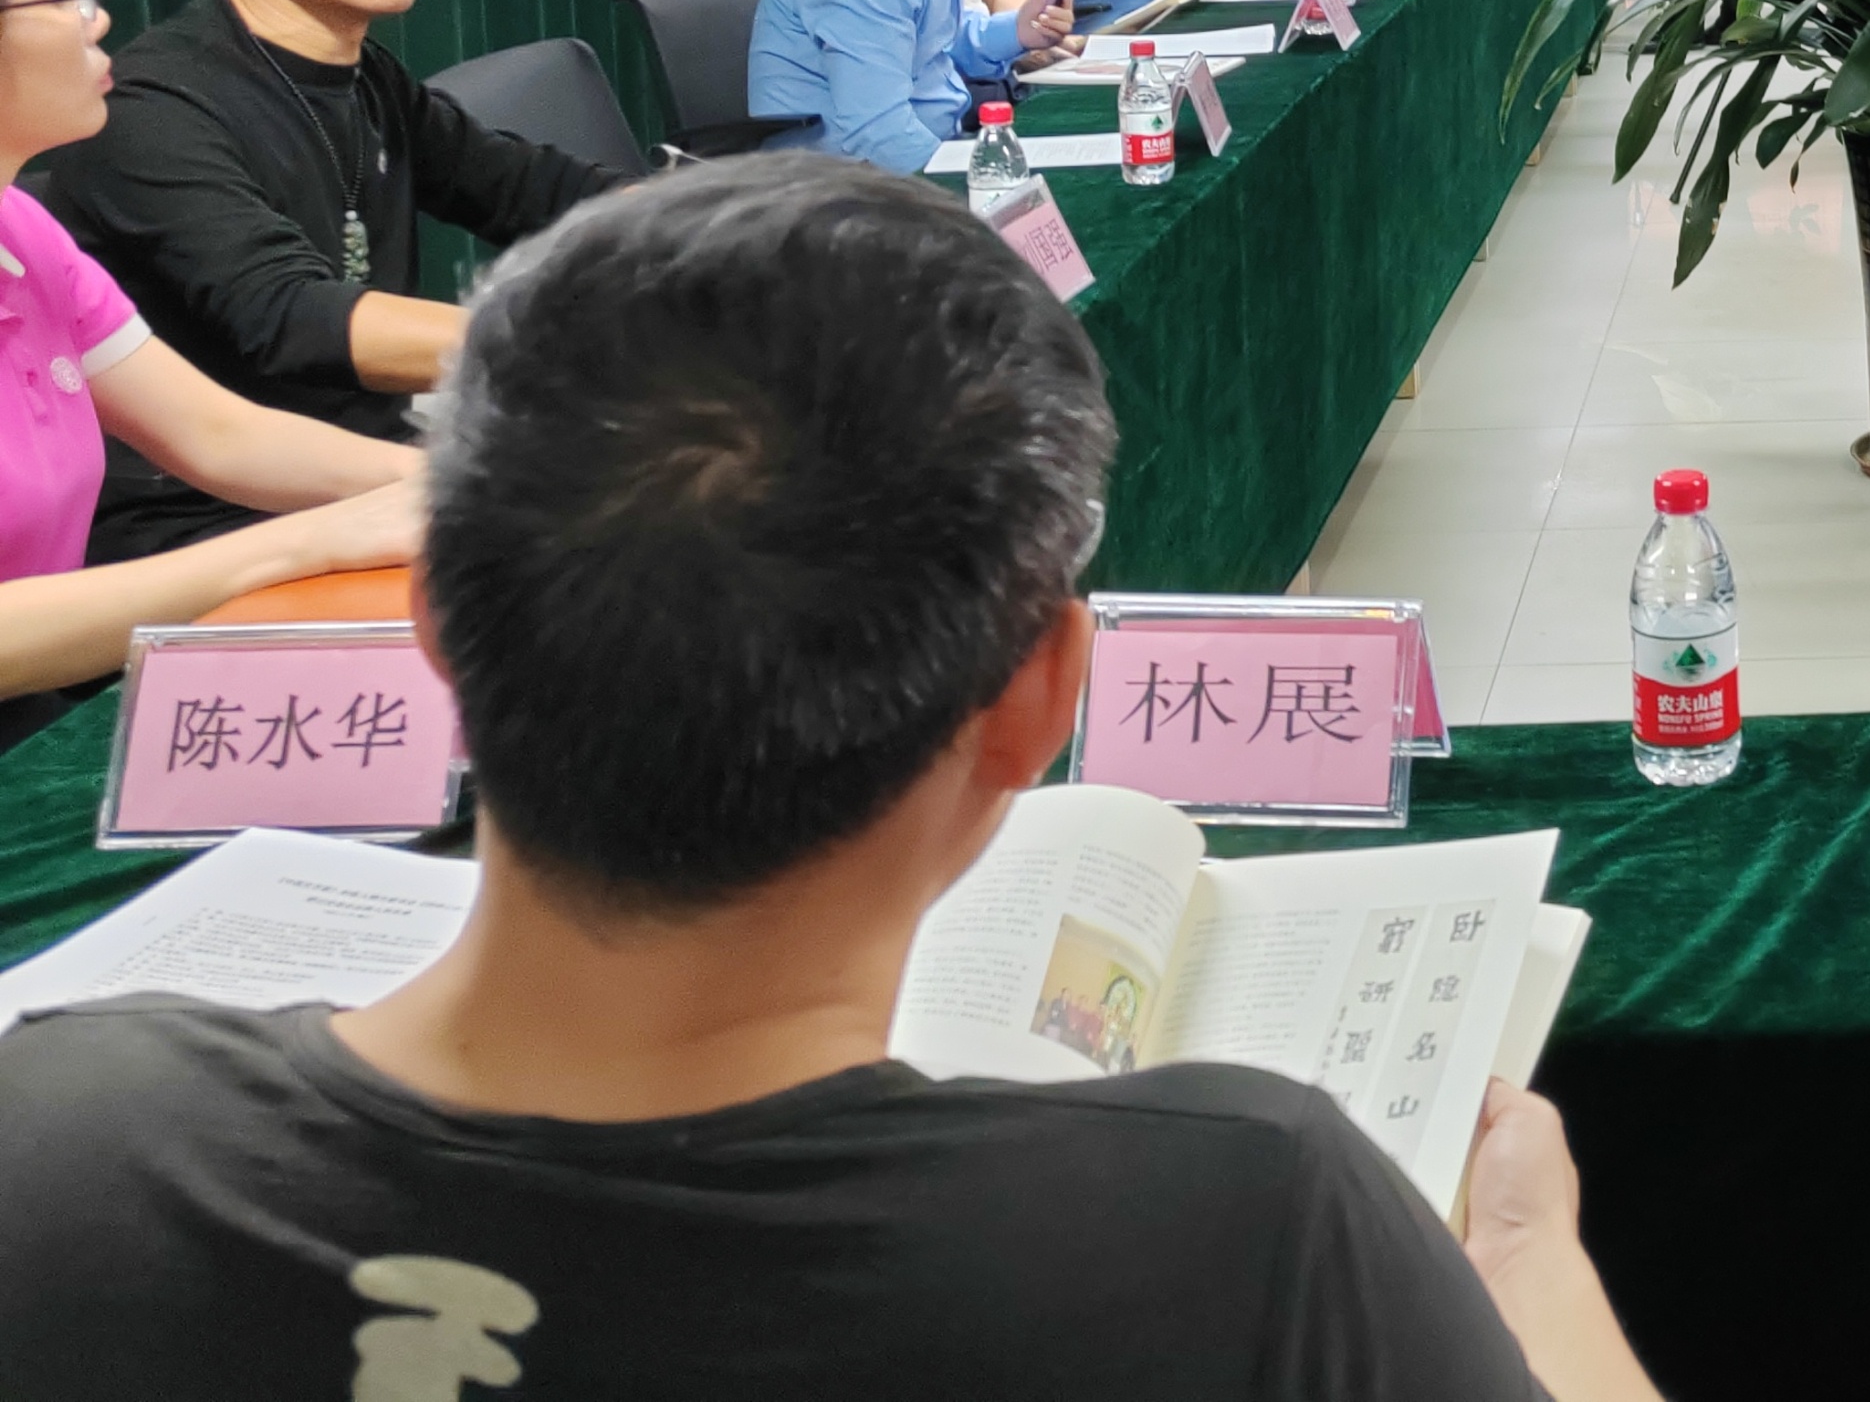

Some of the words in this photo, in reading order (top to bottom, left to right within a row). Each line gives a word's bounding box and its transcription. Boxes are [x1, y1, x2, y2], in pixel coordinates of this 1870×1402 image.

[167, 691, 410, 773] 陈水华
[1117, 660, 1365, 747] 林展
